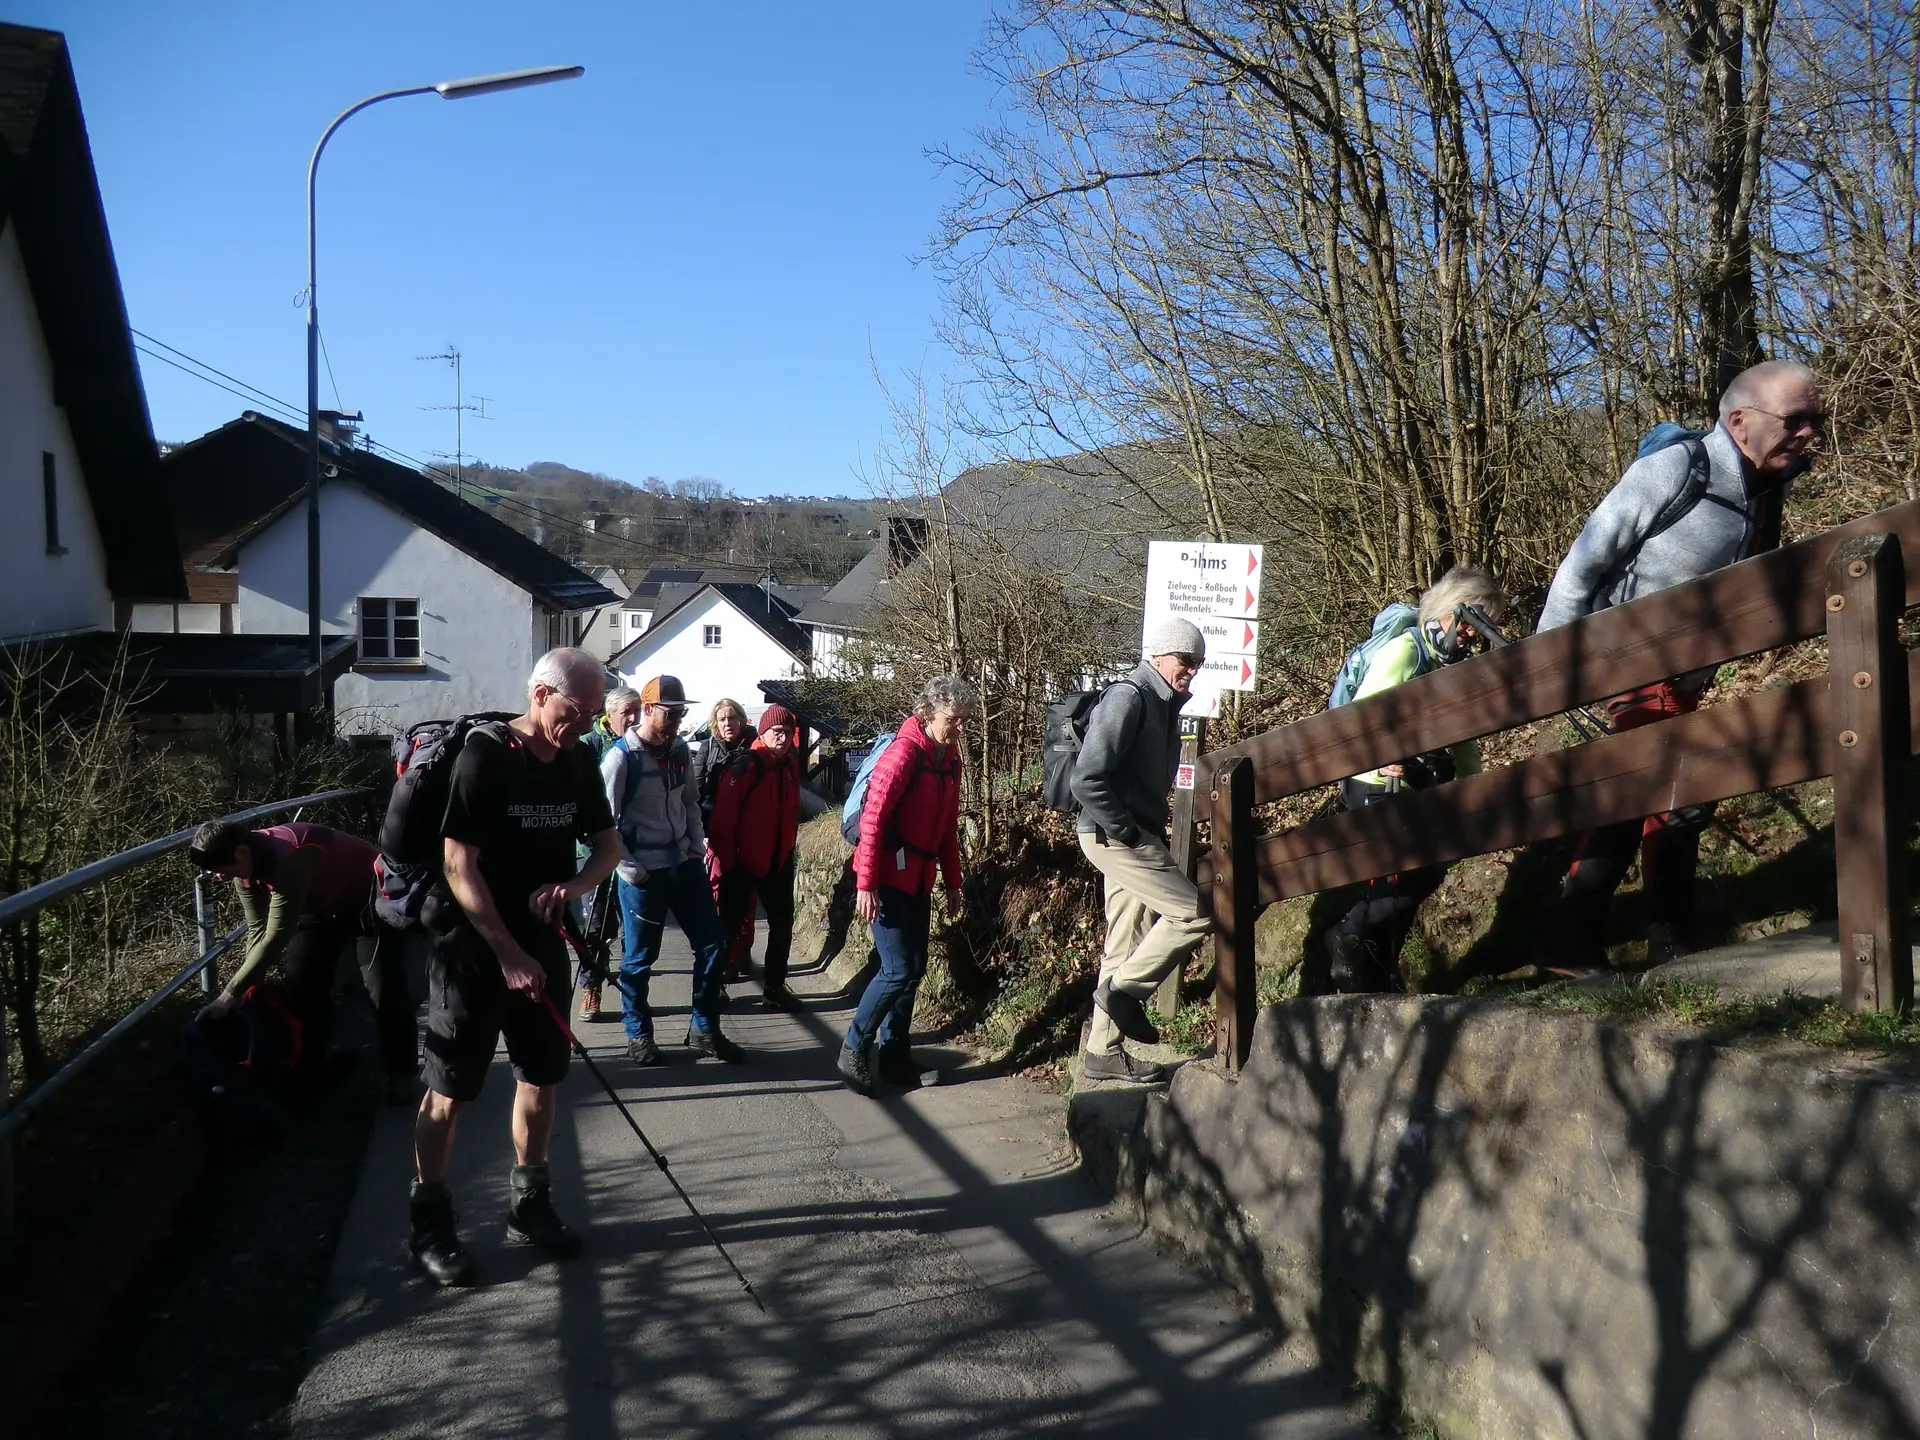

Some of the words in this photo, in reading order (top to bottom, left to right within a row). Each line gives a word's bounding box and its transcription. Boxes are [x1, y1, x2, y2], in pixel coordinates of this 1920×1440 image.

[1167, 580, 1197, 594] Zielweg
[1205, 582, 1238, 593] Roßbach
[1169, 591, 1214, 603] Buchenauer
[1216, 593, 1234, 606] Berg
[1169, 602, 1212, 614] Weißenfels
[1202, 625, 1228, 636] Mühle
